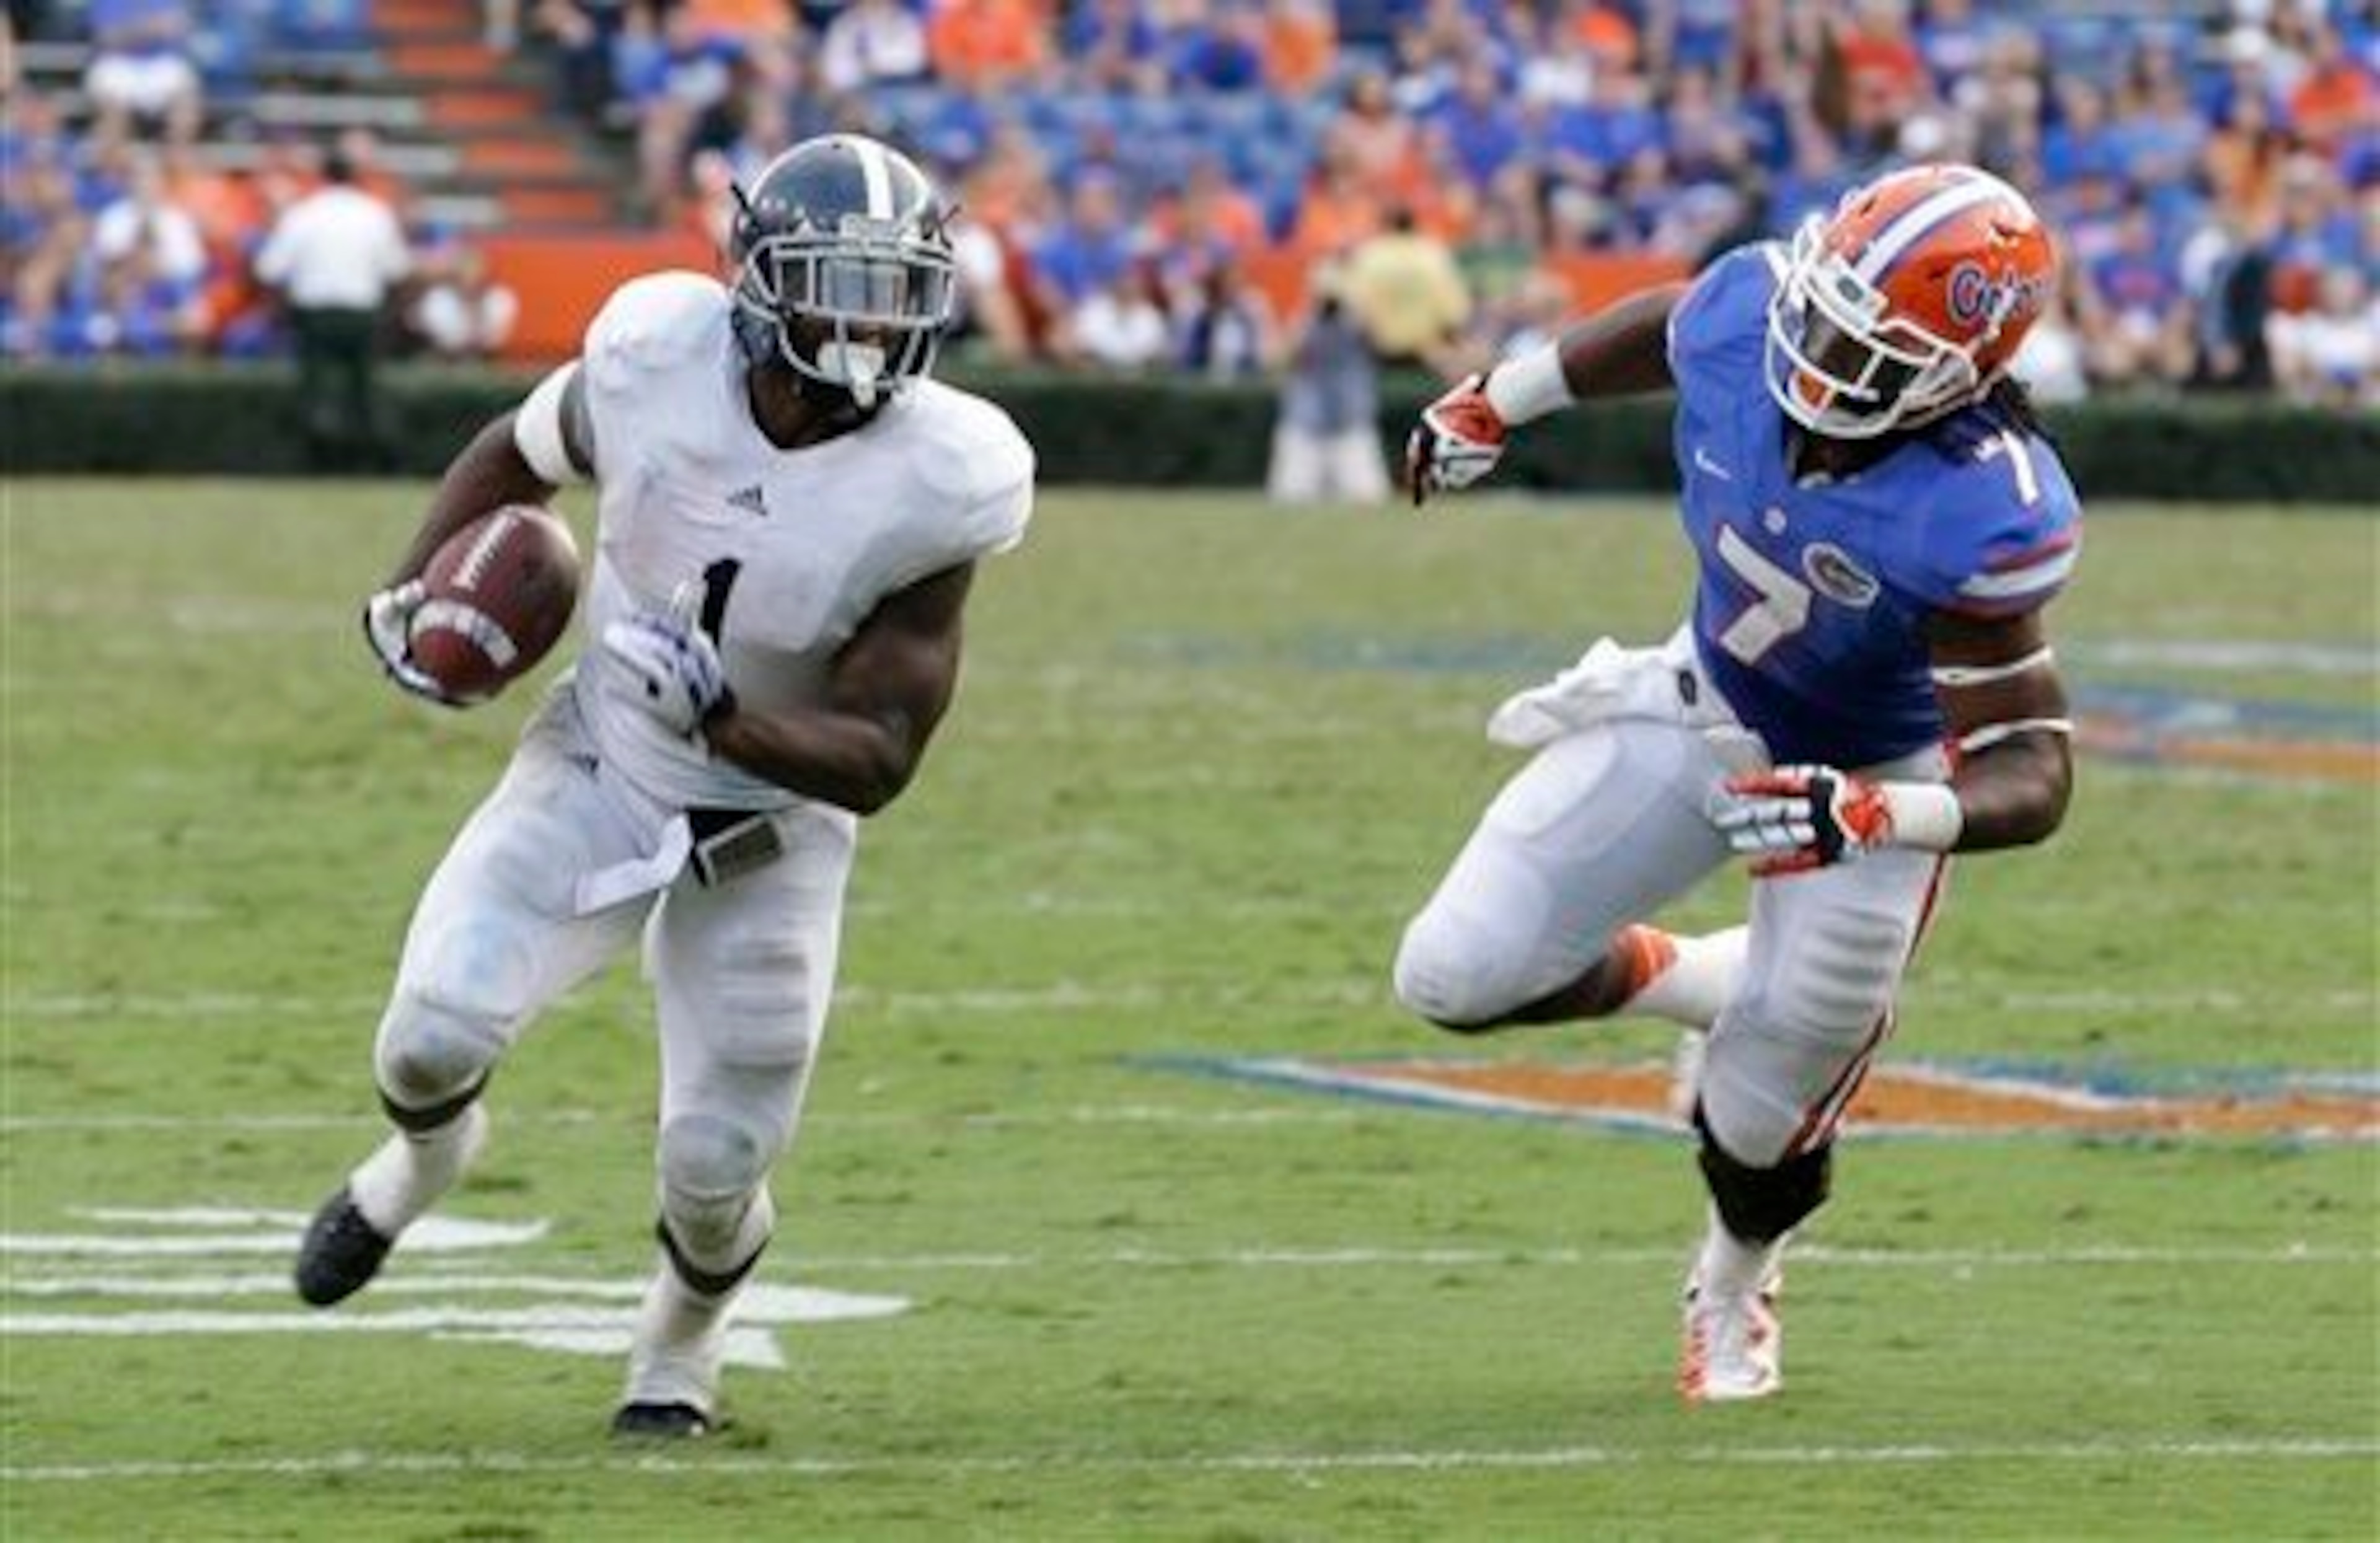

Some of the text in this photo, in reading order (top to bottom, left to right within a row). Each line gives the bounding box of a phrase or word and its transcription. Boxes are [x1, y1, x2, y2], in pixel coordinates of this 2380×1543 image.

[1973, 430, 2039, 507] 7
[700, 558, 742, 648] 1
[1716, 524, 1813, 666] 7
